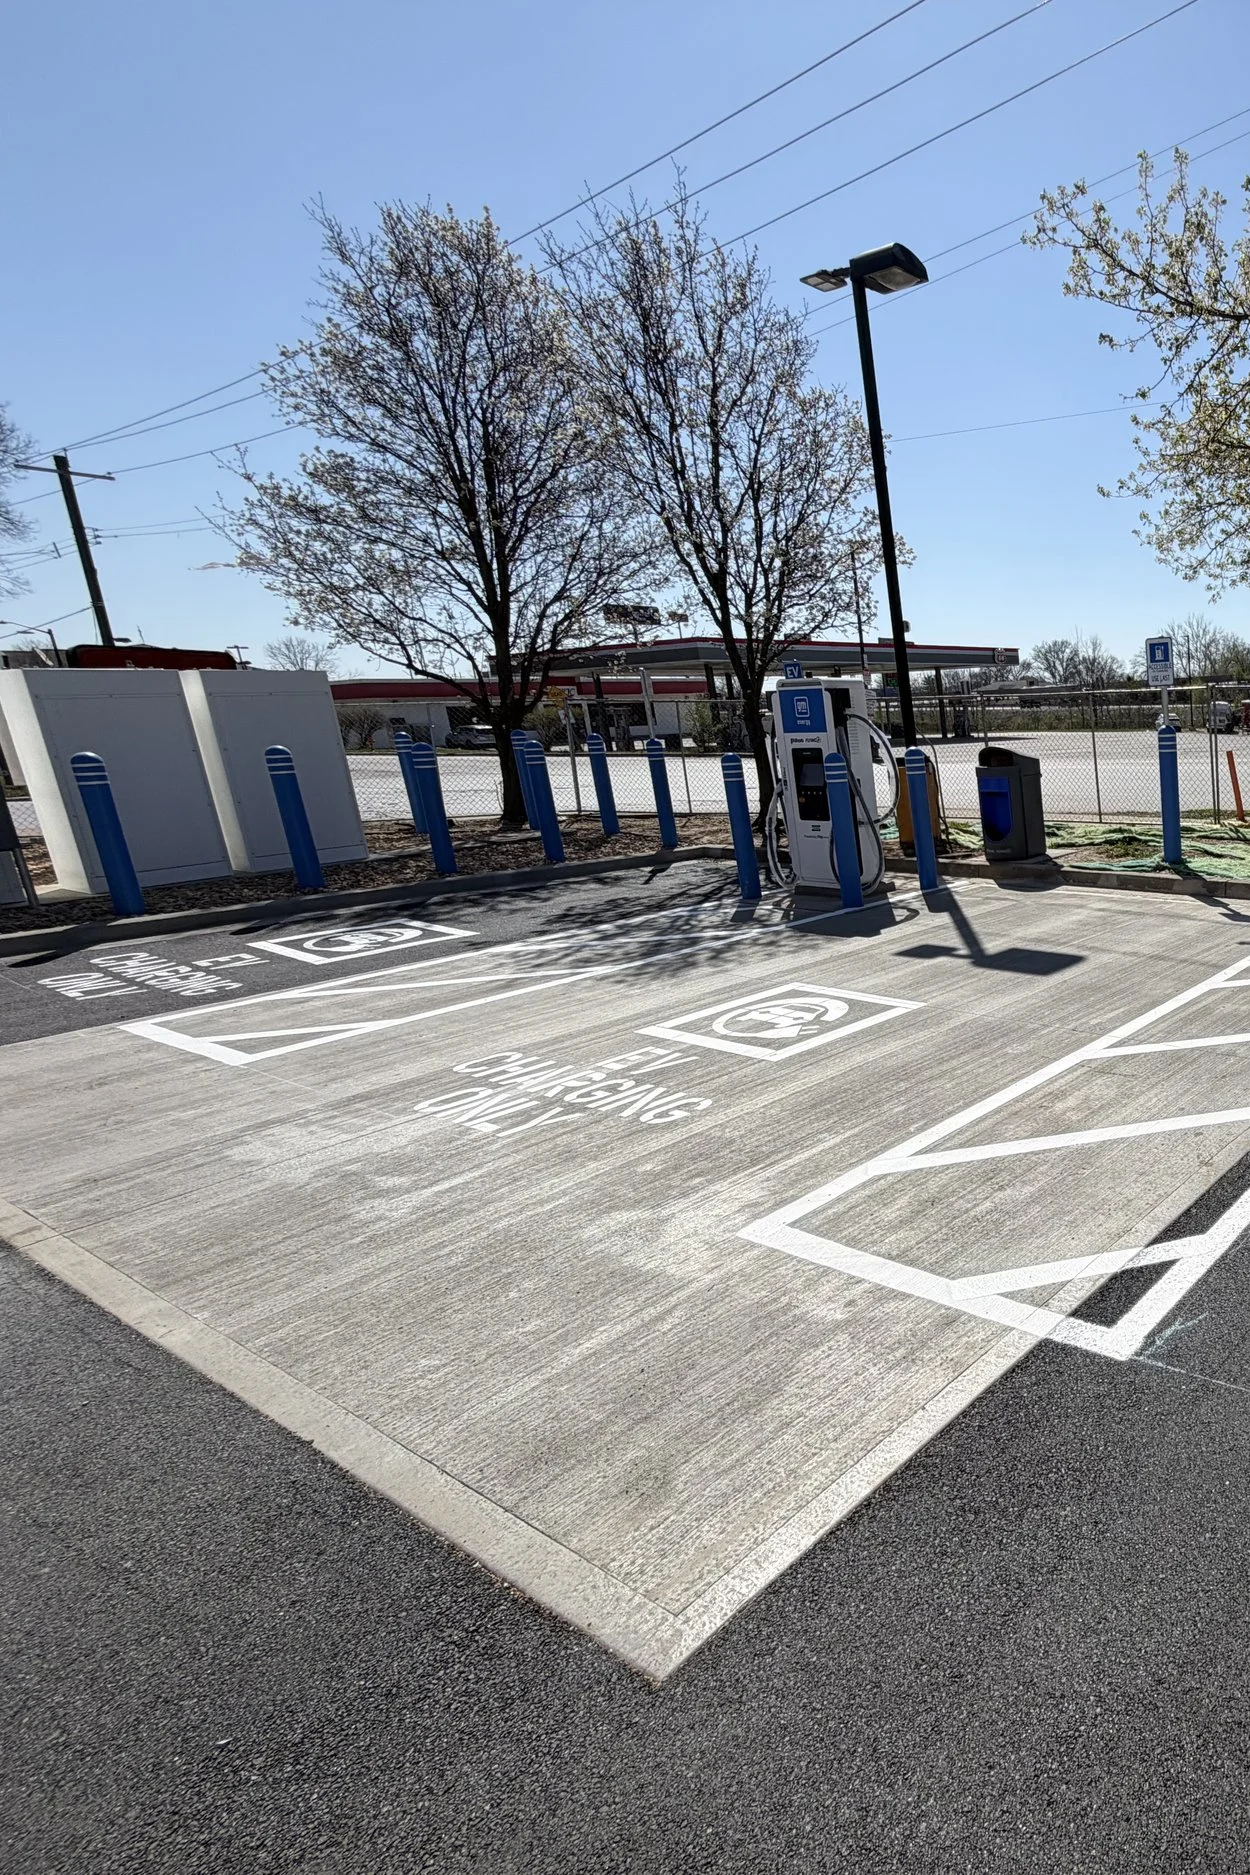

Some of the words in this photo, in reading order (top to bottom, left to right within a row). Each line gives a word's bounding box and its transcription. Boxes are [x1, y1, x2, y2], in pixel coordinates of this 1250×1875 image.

[786, 666, 799, 678] EV
[89, 952, 243, 996] CHARGING
[192, 953, 270, 970] EV
[37, 972, 148, 1000] ONLY
[596, 1046, 700, 1075] EV
[452, 1052, 713, 1124] CHARGING
[413, 1087, 585, 1137] ONLY
